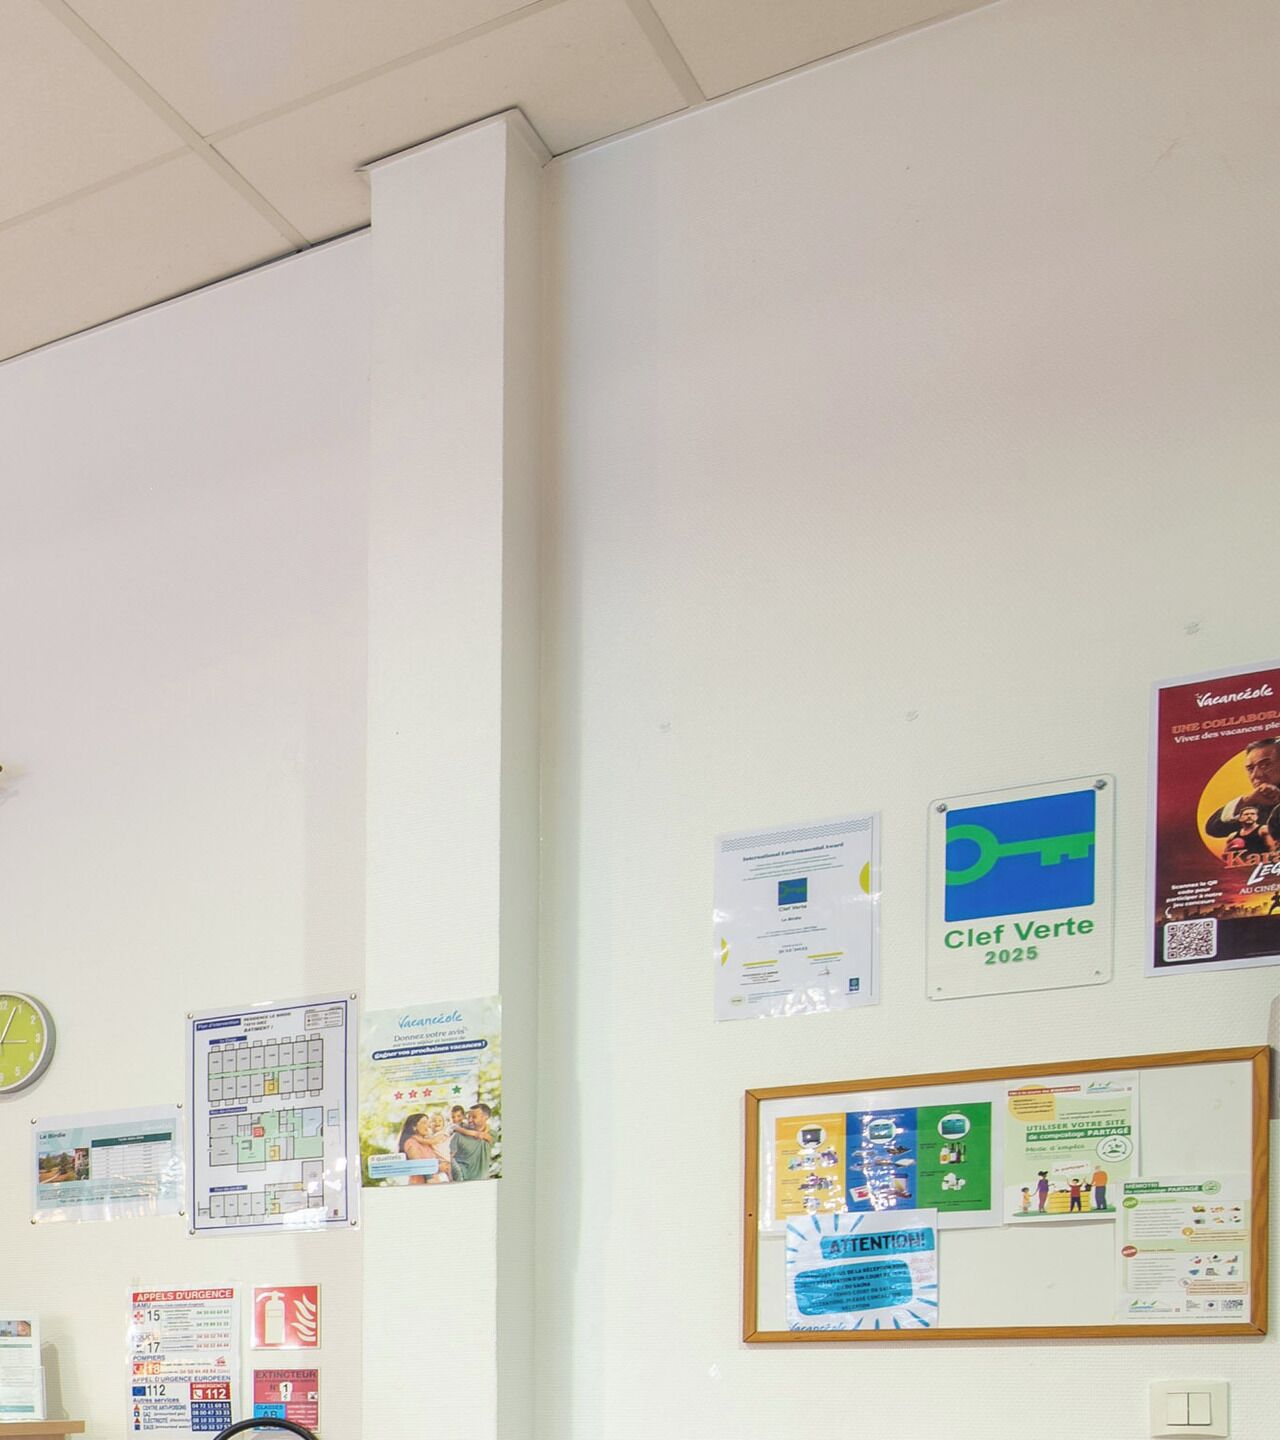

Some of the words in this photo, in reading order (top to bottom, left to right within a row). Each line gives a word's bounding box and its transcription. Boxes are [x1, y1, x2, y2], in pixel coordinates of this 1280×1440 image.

[1195, 684, 1274, 707] Vacancéole
[1171, 722, 1200, 734] UNE
[1174, 735, 1200, 743] Vivez
[1201, 731, 1219, 740] des
[1220, 724, 1263, 736] vacances
[1240, 887, 1253, 895] AU
[944, 924, 1006, 949] Clef
[1013, 917, 1094, 941] Verte
[985, 946, 1038, 965] 2025
[0, 1000, 8, 1010] 12
[31, 1015, 35, 1024] 2
[398, 1008, 464, 1029] Vacancéole
[35, 1033, 40, 1043] 3
[393, 1033, 423, 1042] Donnez
[425, 1031, 447, 1039] votre
[29, 1051, 34, 1061] 4
[411, 1045, 450, 1056] prochaines
[15, 1066, 20, 1076] 5
[1026, 1123, 1068, 1132] UTILISER
[137, 1292, 174, 1301] APPELS
[175, 1289, 232, 1299] D'URGENCE
[147, 1309, 160, 1321] 15
[147, 1342, 160, 1353] 17
[256, 1370, 316, 1378] EXTINCTEUR
[147, 1384, 166, 1396] 112
[282, 1384, 288, 1392] 1
[206, 1389, 226, 1399] 112
[263, 1410, 277, 1418] AB
